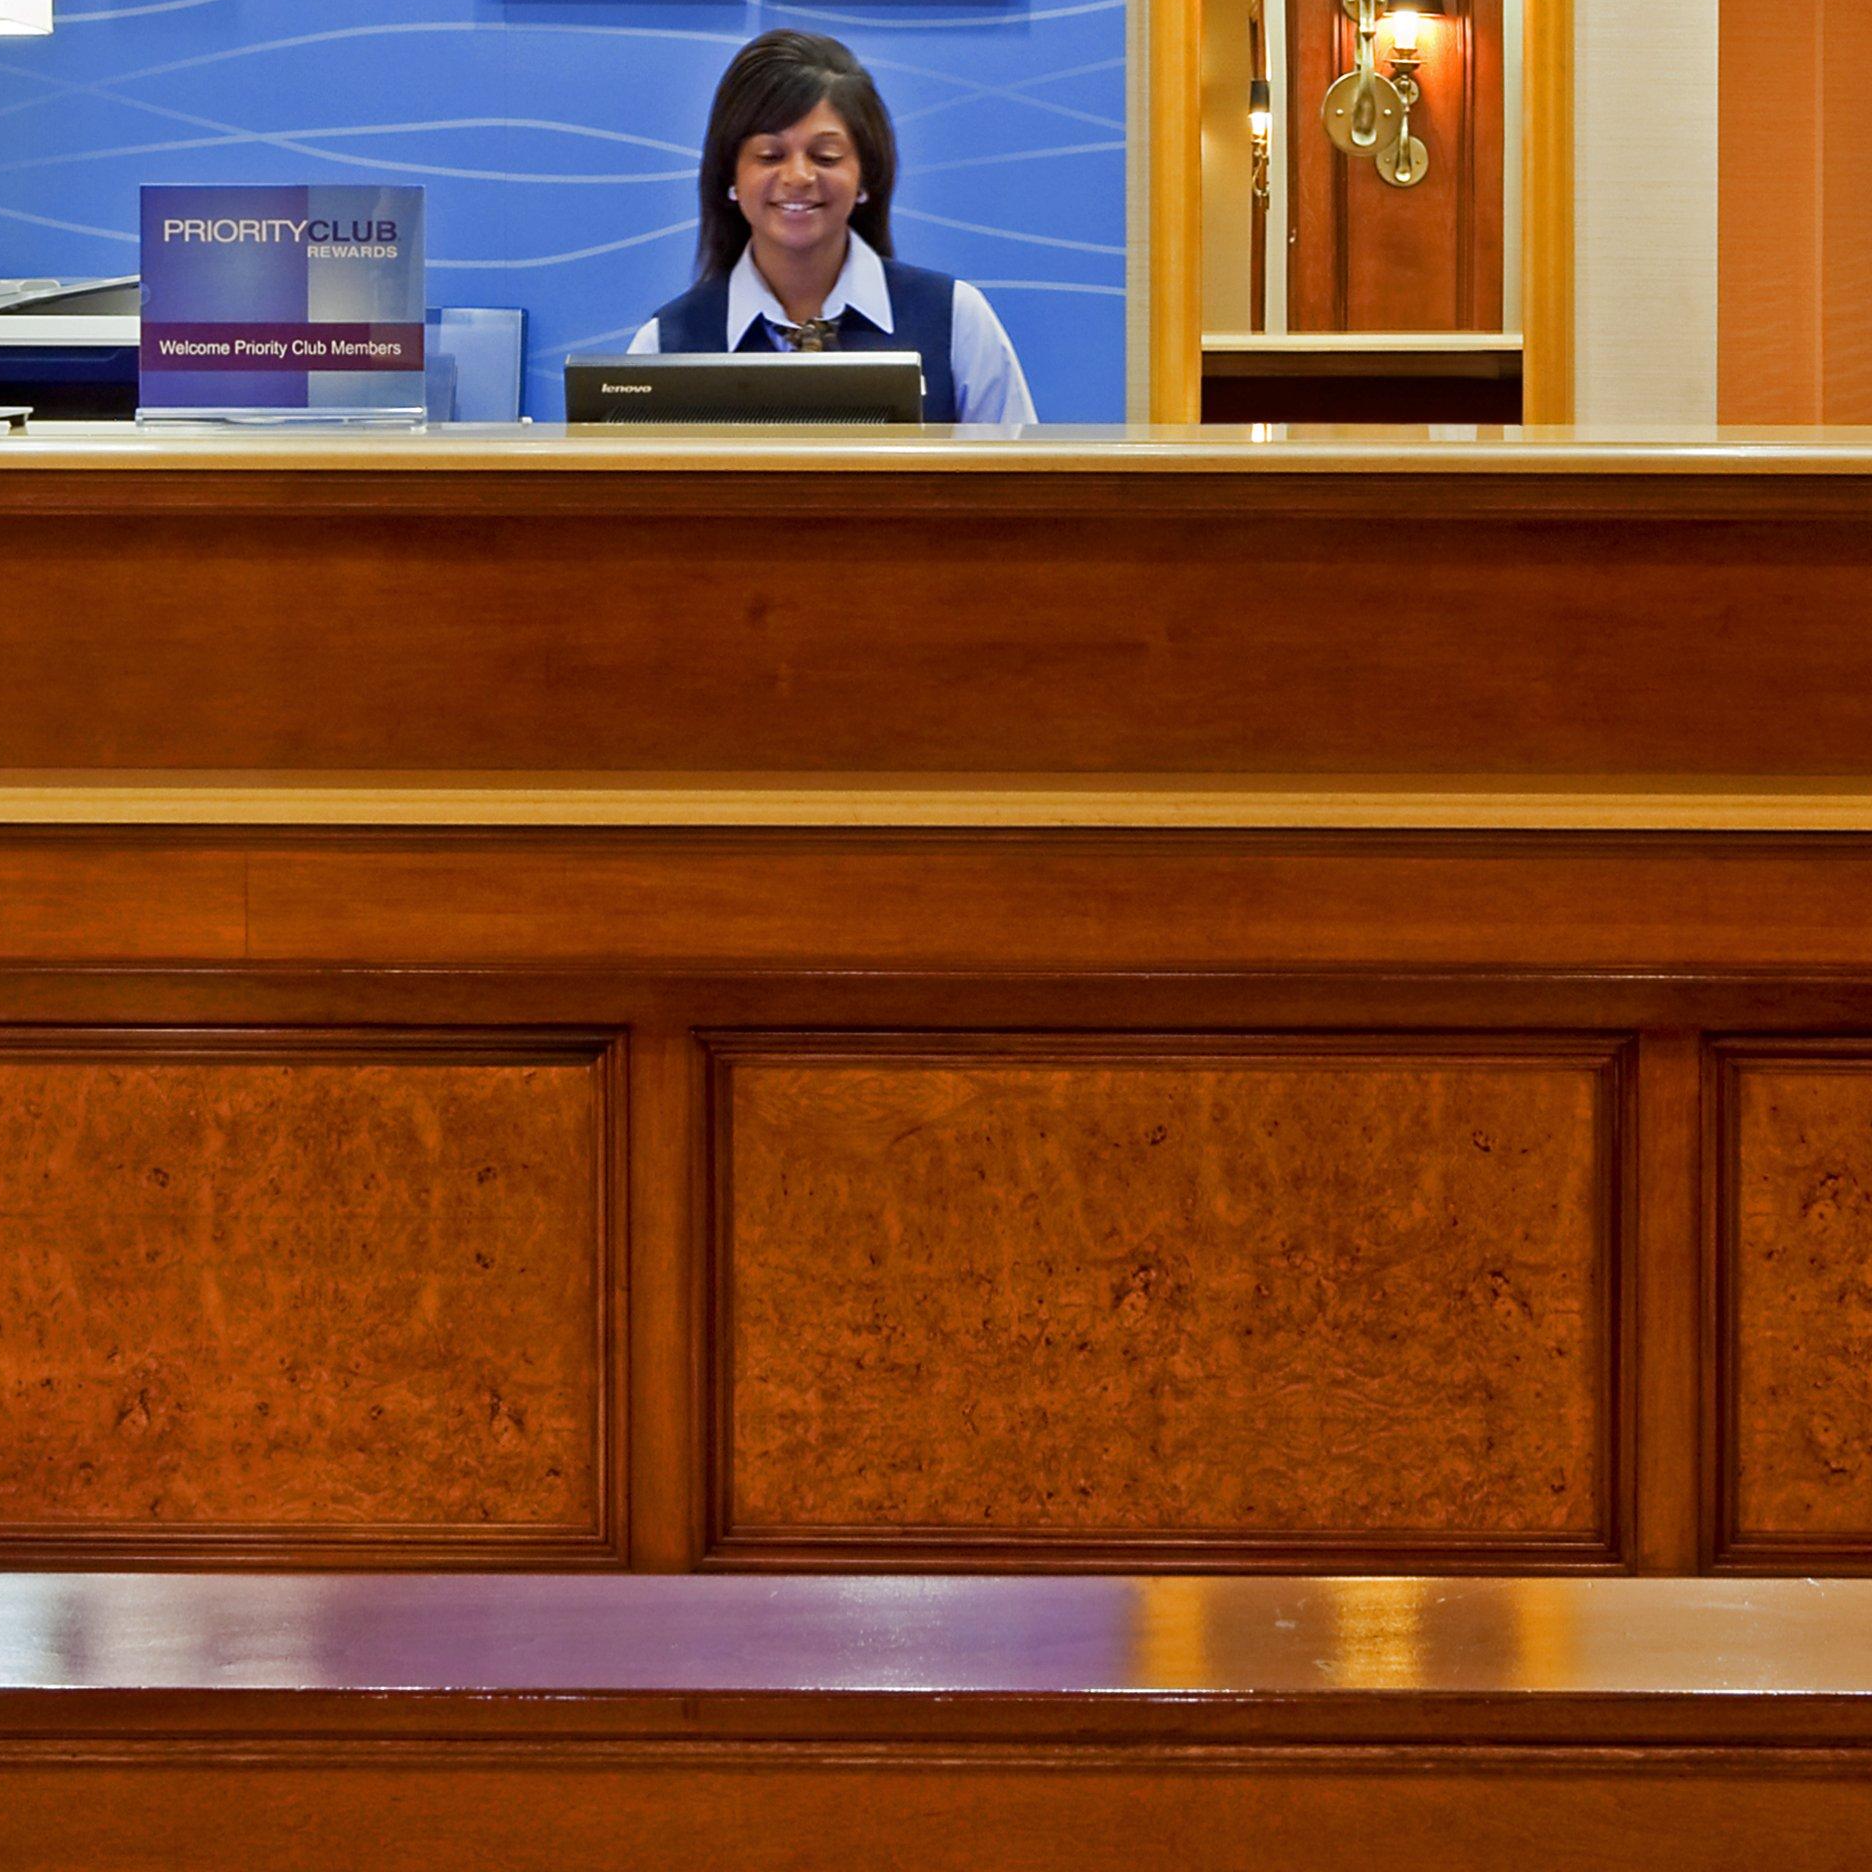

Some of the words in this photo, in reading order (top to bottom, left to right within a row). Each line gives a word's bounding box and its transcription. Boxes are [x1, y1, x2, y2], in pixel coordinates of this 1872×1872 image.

[306, 245, 398, 259] REWARDS
[159, 339, 231, 356] Welcome
[234, 339, 288, 359] Priority
[291, 339, 327, 356] Club
[330, 339, 402, 356] Members
[600, 382, 653, 394] lenovo
